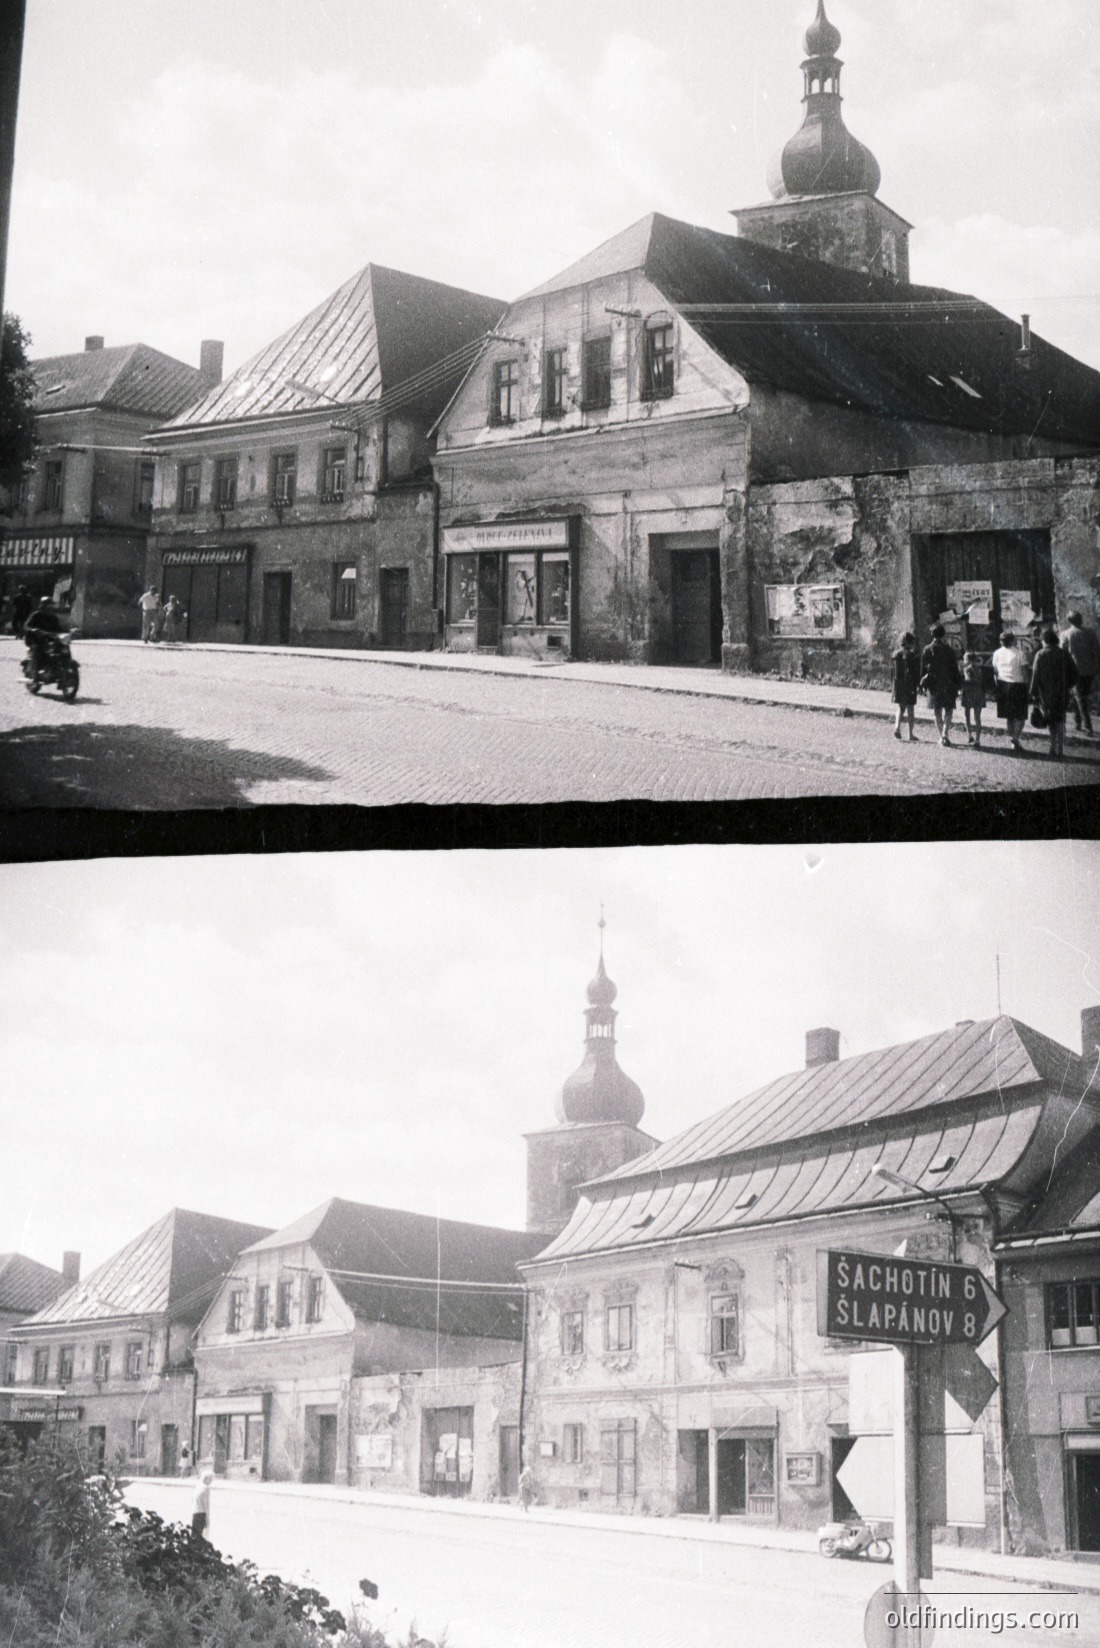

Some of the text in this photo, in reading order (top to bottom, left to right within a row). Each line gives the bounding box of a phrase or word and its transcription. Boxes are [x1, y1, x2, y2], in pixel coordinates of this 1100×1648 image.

[837, 1255, 976, 1299] ŠACHOTÍN 6
[836, 1293, 976, 1337] ŠLAPÁNOV 8
